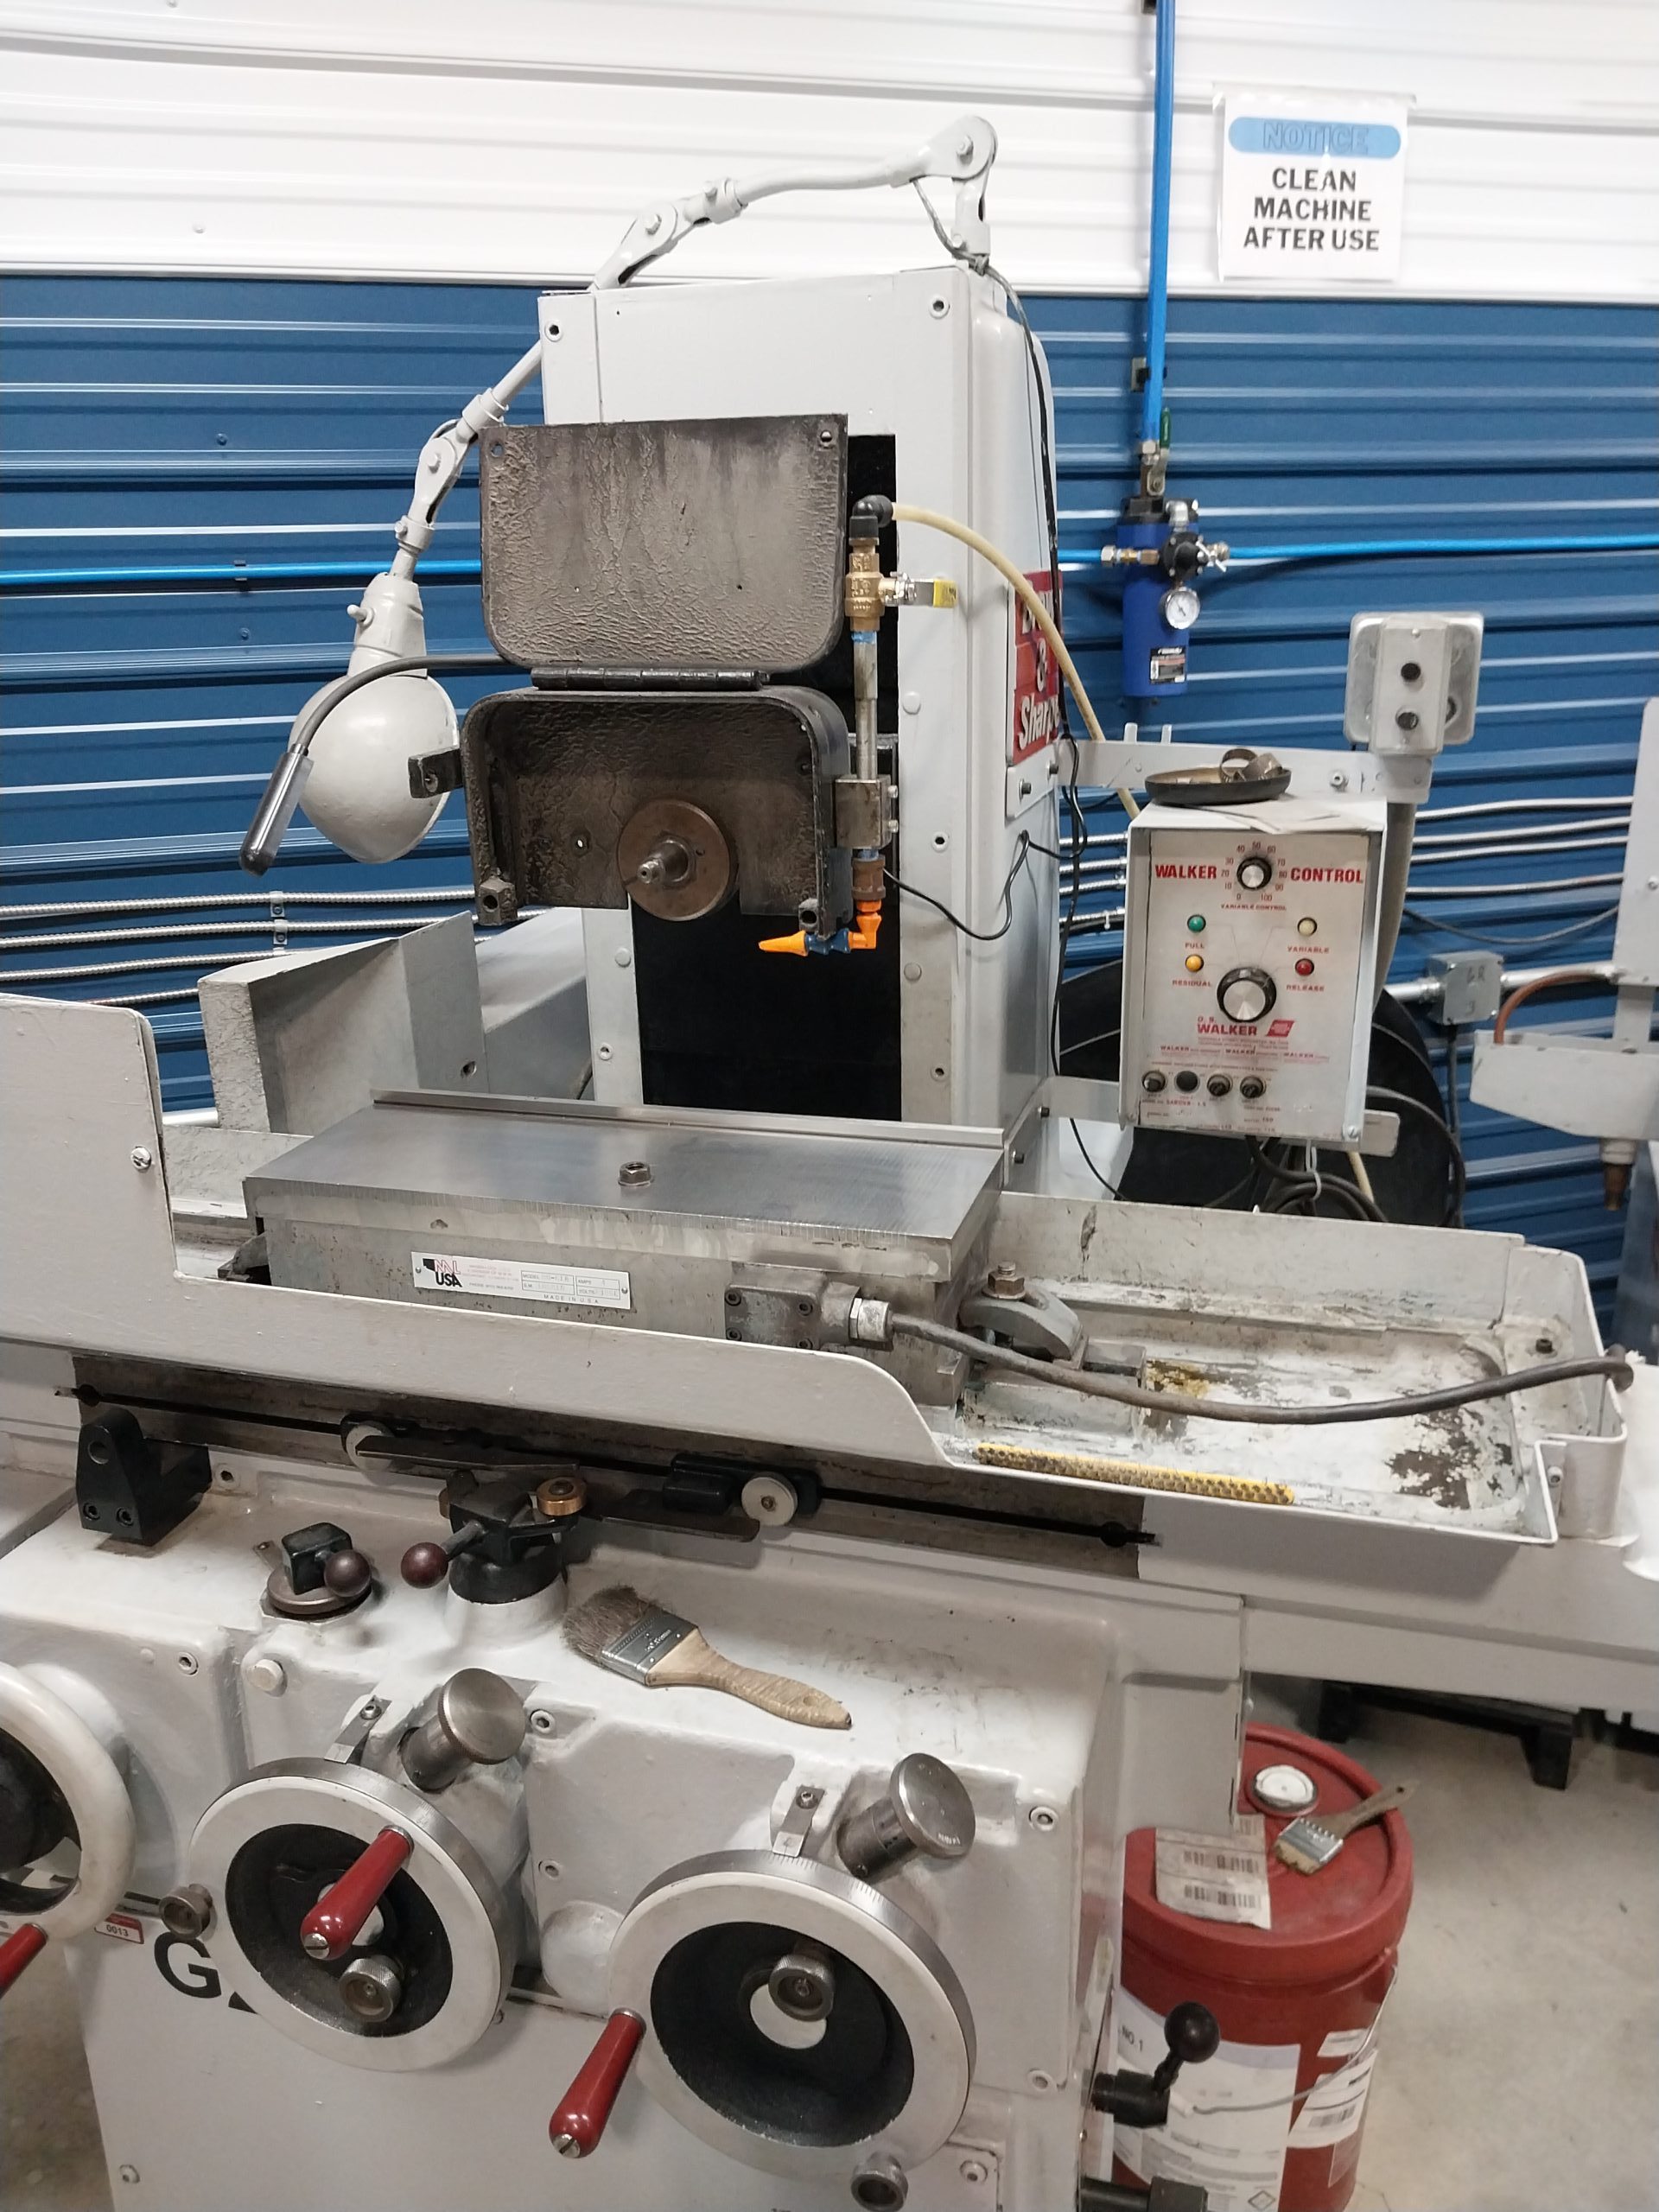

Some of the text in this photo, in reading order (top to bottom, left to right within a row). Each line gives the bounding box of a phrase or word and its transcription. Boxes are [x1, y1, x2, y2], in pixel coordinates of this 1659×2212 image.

[1262, 121, 1369, 154] NOTICE
[1272, 168, 1356, 192] CLEAN
[1254, 197, 1371, 221] MACHINE
[1243, 226, 1379, 251] AFTER USE
[1019, 694, 1058, 750] Sharpe
[1236, 844, 1245, 853] 40
[1252, 842, 1261, 850] 50
[1277, 858, 1286, 867] 70
[1155, 865, 1217, 880] WALKER
[1290, 867, 1363, 883] CONTROL
[1287, 945, 1330, 954] VARIABLE
[1172, 979, 1212, 988] RESIDUAL
[1286, 984, 1325, 993] RELEASE
[1198, 1023, 1257, 1036] WALKER
[435, 1272, 462, 1287] USA
[105, 1923, 130, 1937] 0013
